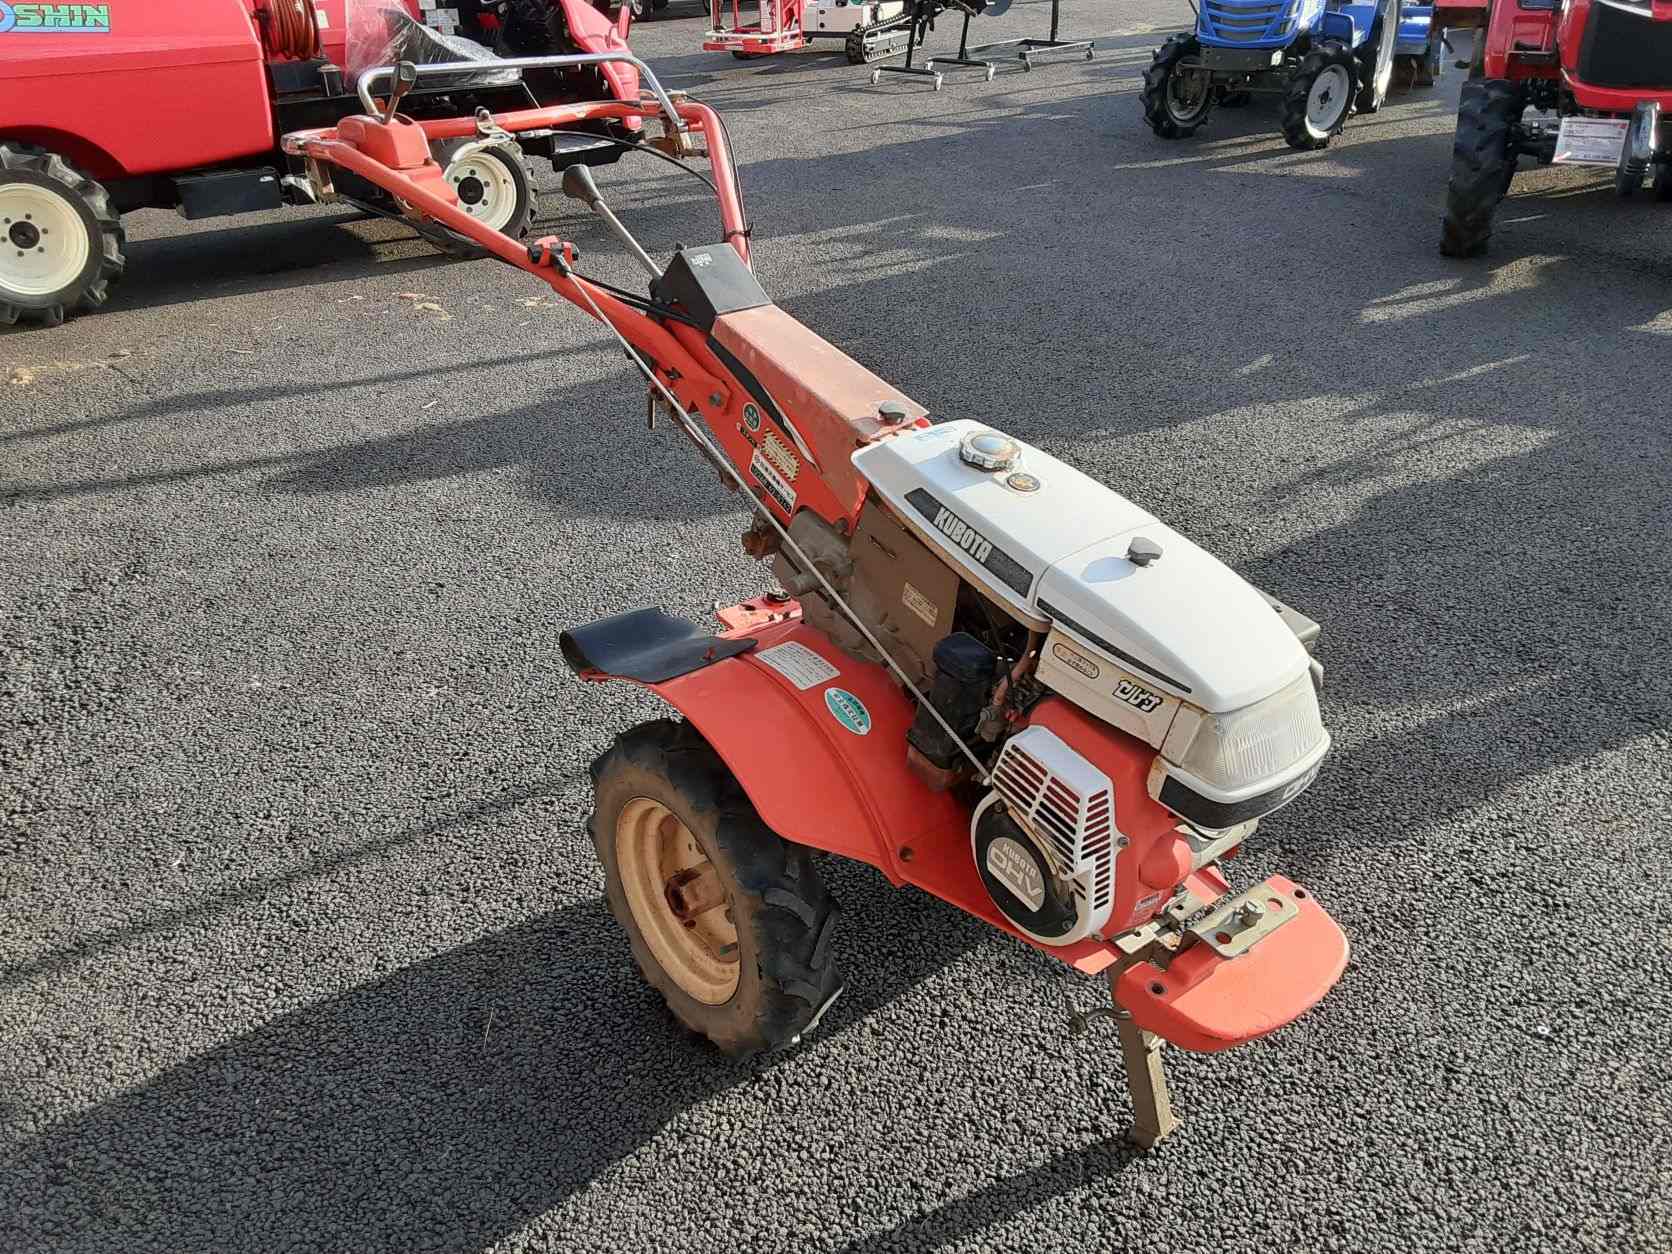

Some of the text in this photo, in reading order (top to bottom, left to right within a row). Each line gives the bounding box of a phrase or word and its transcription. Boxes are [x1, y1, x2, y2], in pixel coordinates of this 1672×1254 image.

[933, 506, 993, 564] KUBOTA
[990, 846, 1042, 896] OHV
[1002, 843, 1037, 877] KUBOTA
